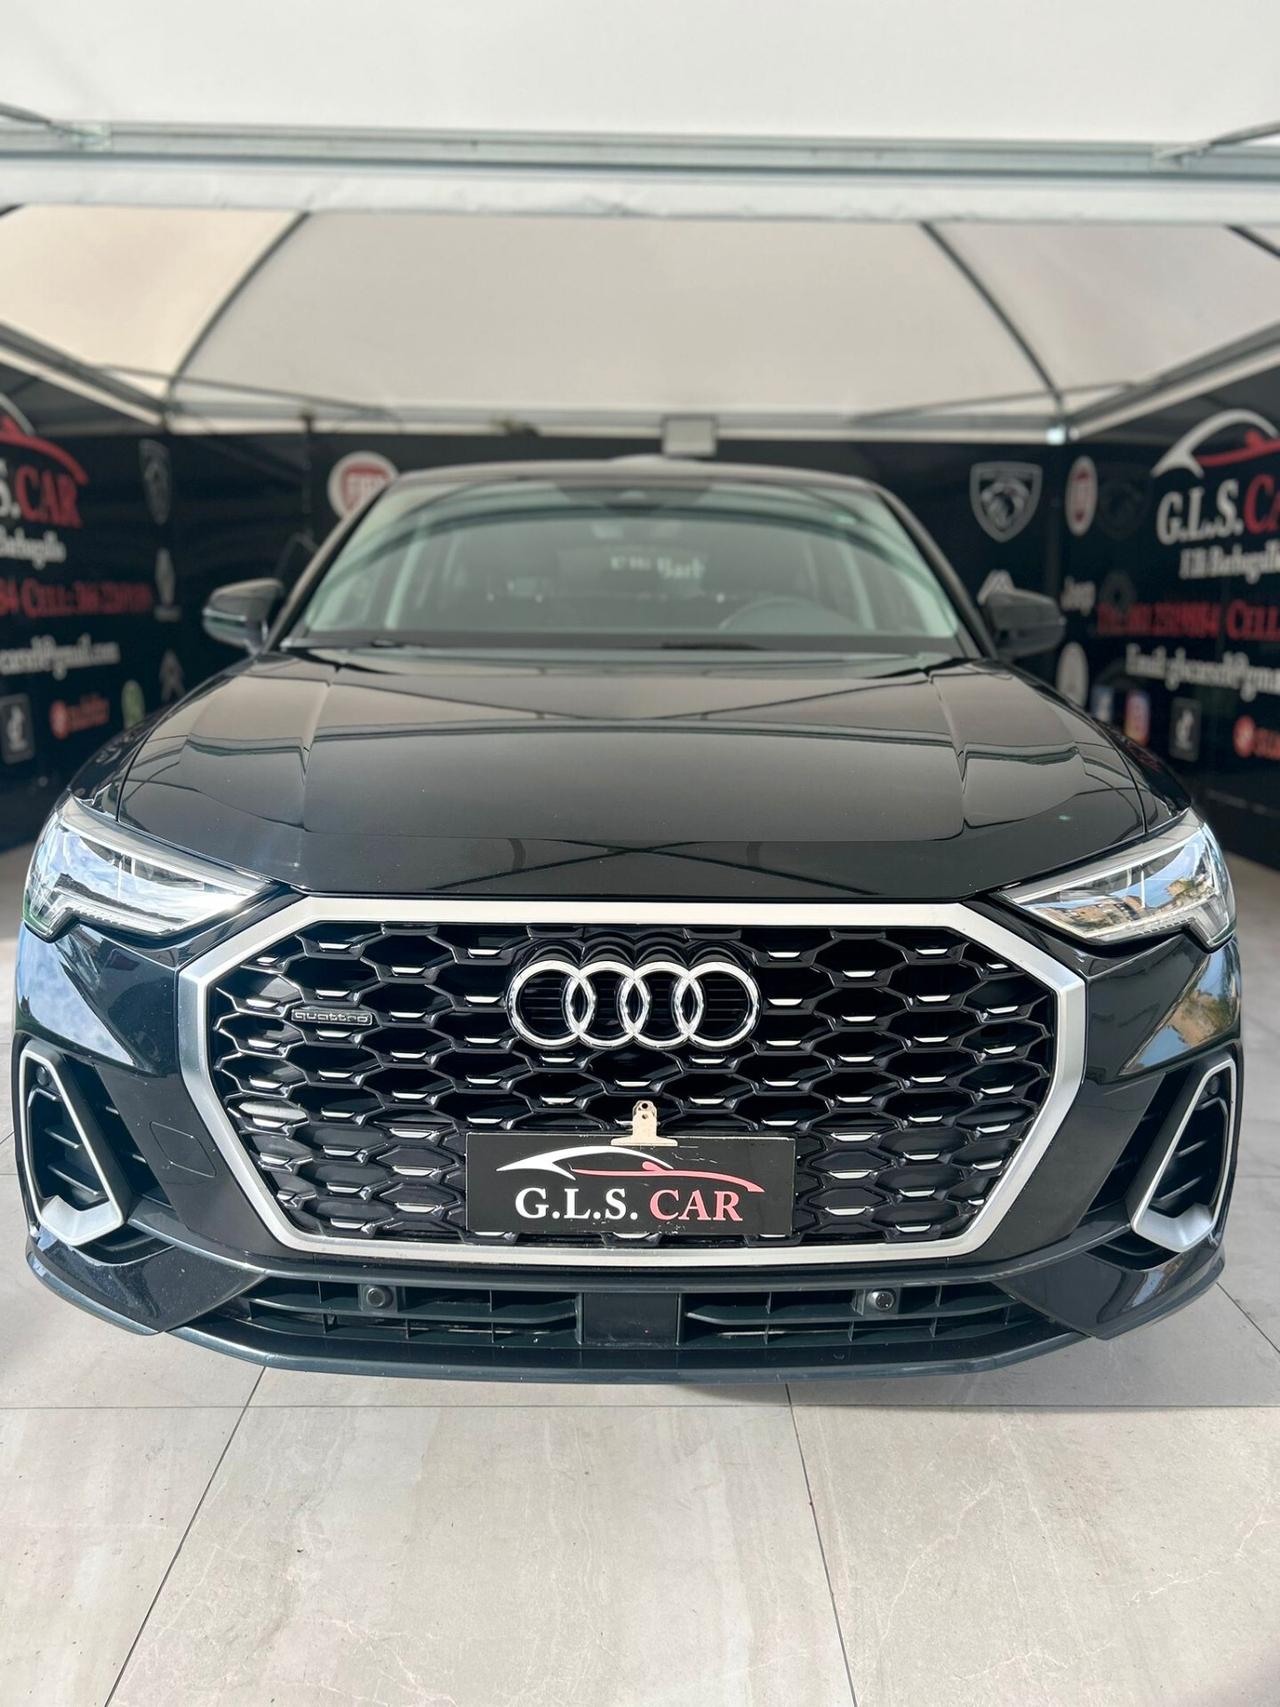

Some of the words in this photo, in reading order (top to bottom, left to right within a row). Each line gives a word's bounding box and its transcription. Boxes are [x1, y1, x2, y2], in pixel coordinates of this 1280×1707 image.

[16, 465, 82, 528] CAR
[1156, 478, 1244, 545] G.L.S.
[294, 1011, 370, 1023] quattro
[514, 1187, 638, 1220] G.L.S.
[649, 1189, 743, 1222] CAR
